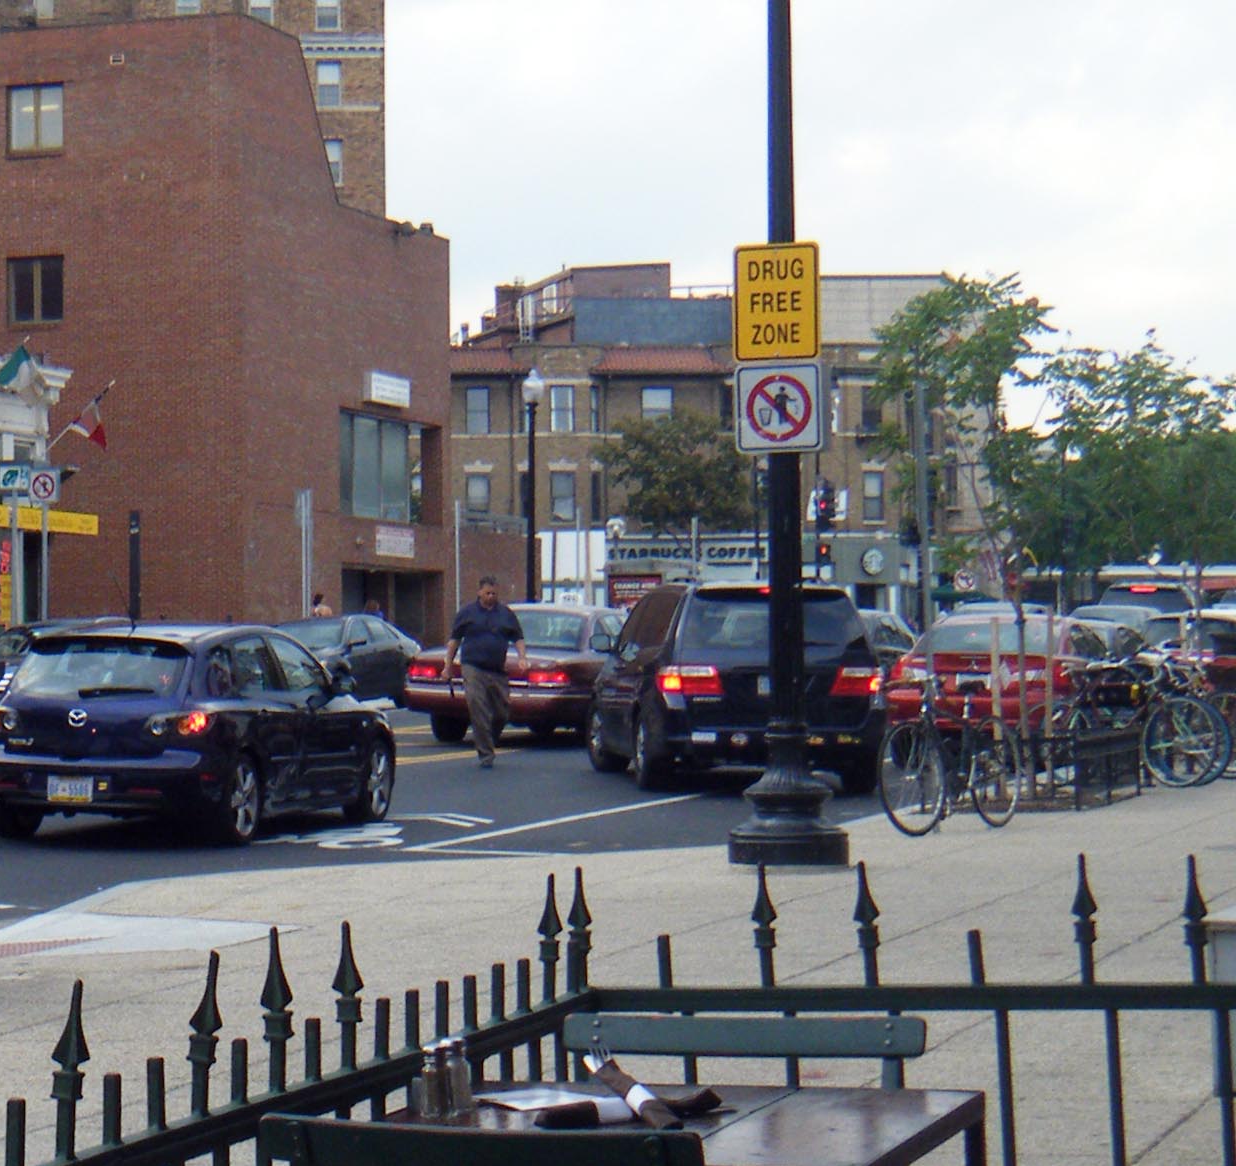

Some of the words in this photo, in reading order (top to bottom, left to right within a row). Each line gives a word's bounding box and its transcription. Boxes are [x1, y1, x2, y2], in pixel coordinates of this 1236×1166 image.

[748, 258, 804, 281] DRUG
[750, 291, 802, 313] FREE
[751, 322, 801, 345] ZONE
